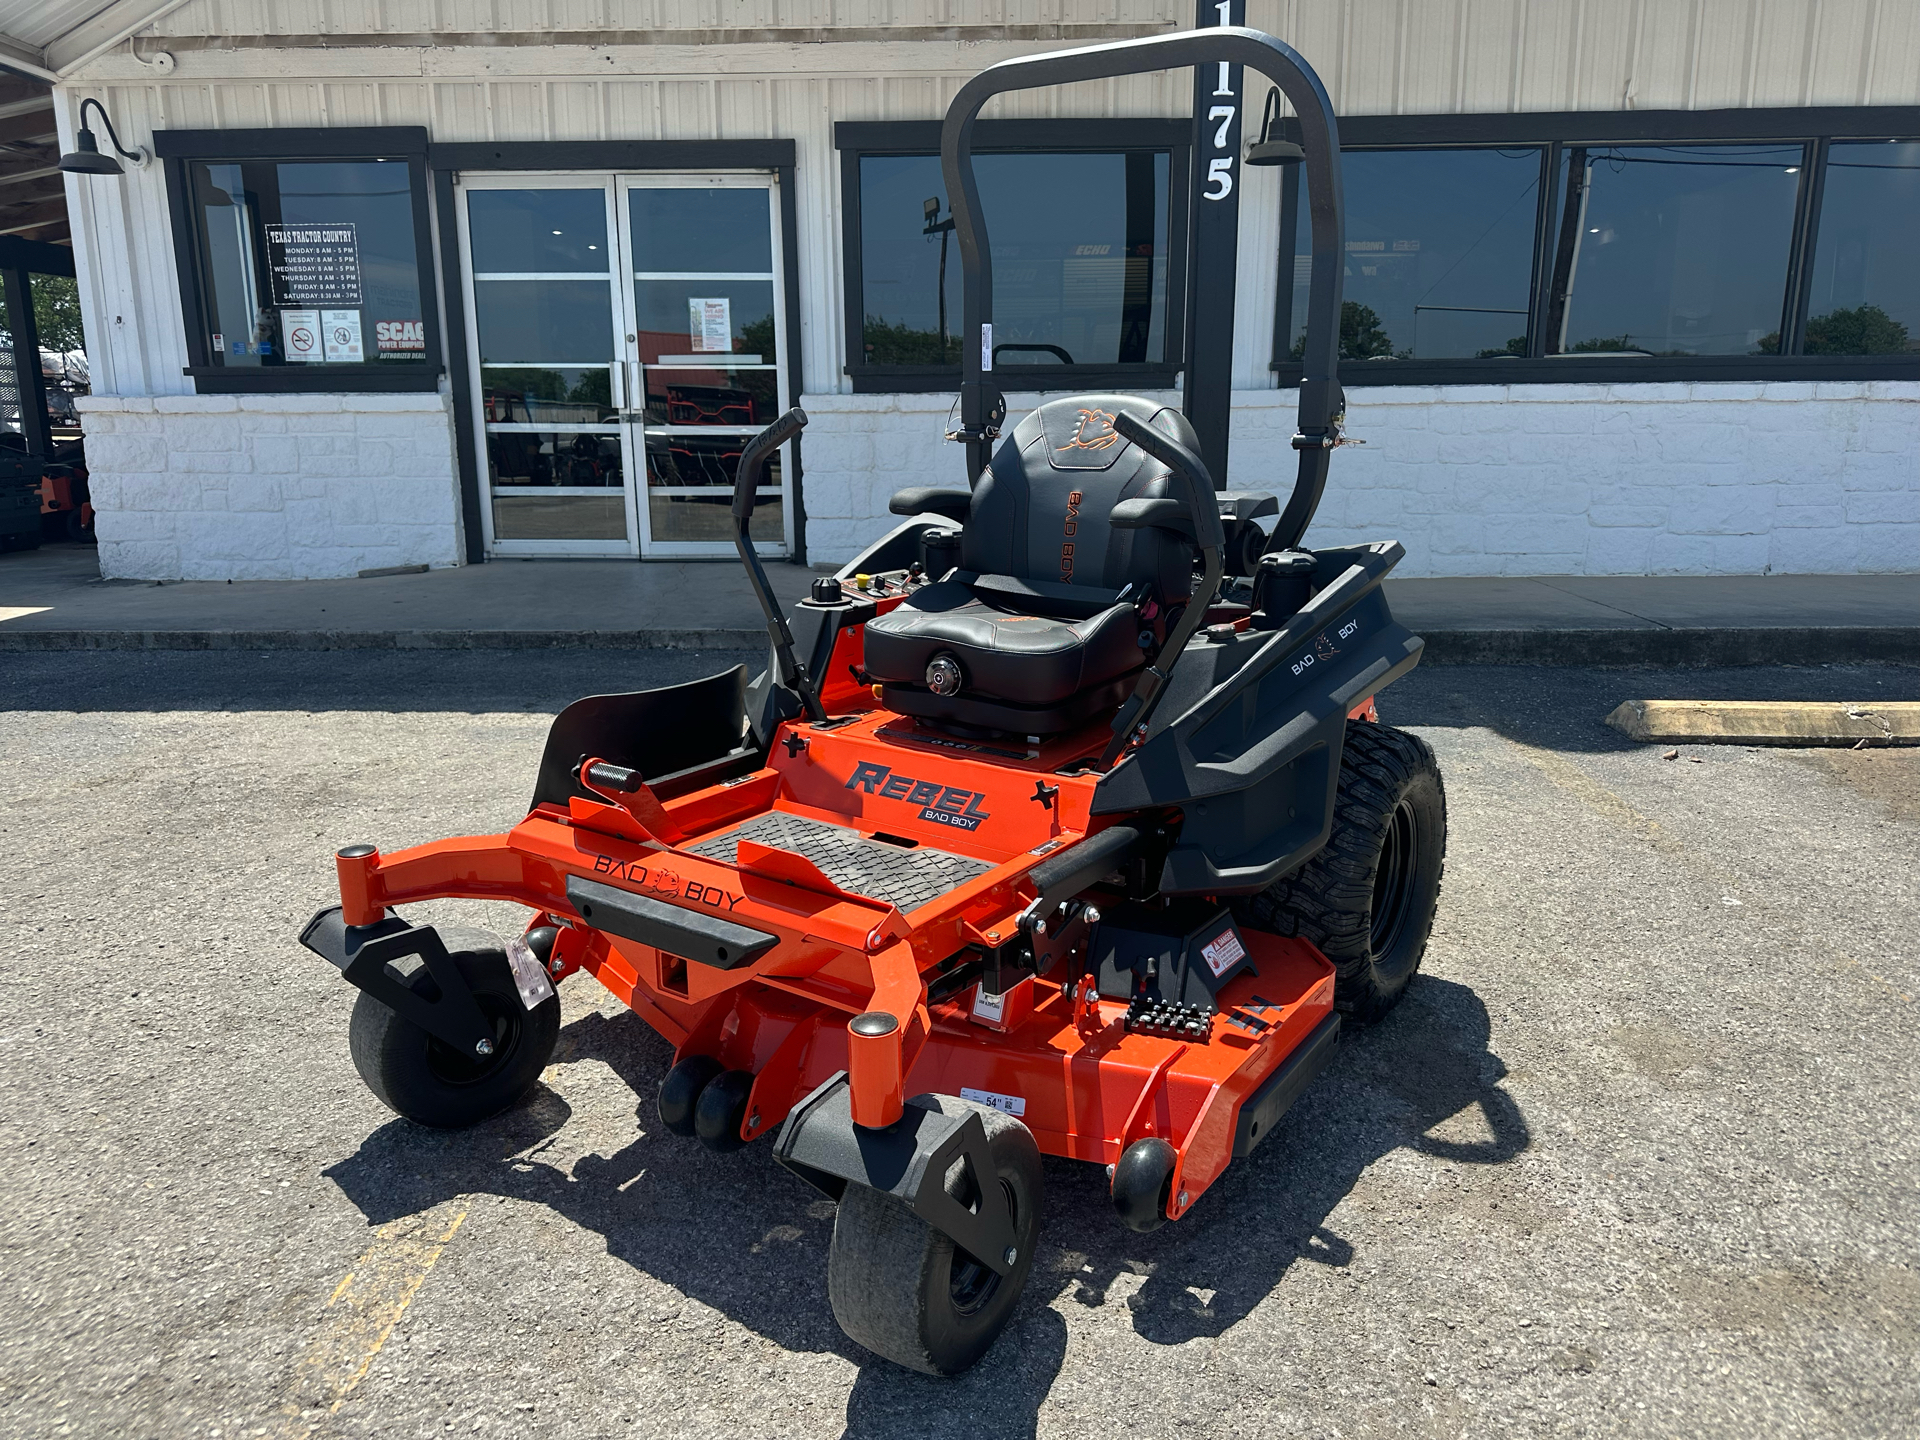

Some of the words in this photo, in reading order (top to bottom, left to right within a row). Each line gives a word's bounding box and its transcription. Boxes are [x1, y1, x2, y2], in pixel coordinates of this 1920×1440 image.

[1203, 0, 1236, 201] 1175
[270, 231, 292, 243] TEXAS
[292, 230, 322, 243] TRACTOR
[322, 230, 352, 243] COUNTRY
[1075, 244, 1112, 256] ECHO
[377, 341, 398, 349] POWER
[379, 352, 411, 360] AUTHORIZED
[1061, 490, 1083, 538] BAD
[1059, 541, 1077, 586] BOY
[1290, 653, 1315, 676] BAD
[1337, 618, 1359, 640] BOY
[845, 760, 991, 820] REBEL
[924, 808, 948, 822] BAD
[949, 813, 976, 829] BOY
[593, 854, 648, 884] BAD
[682, 880, 746, 912] BOY
[1217, 931, 1235, 948] DANGER
[985, 1096, 1003, 1108] 54"
